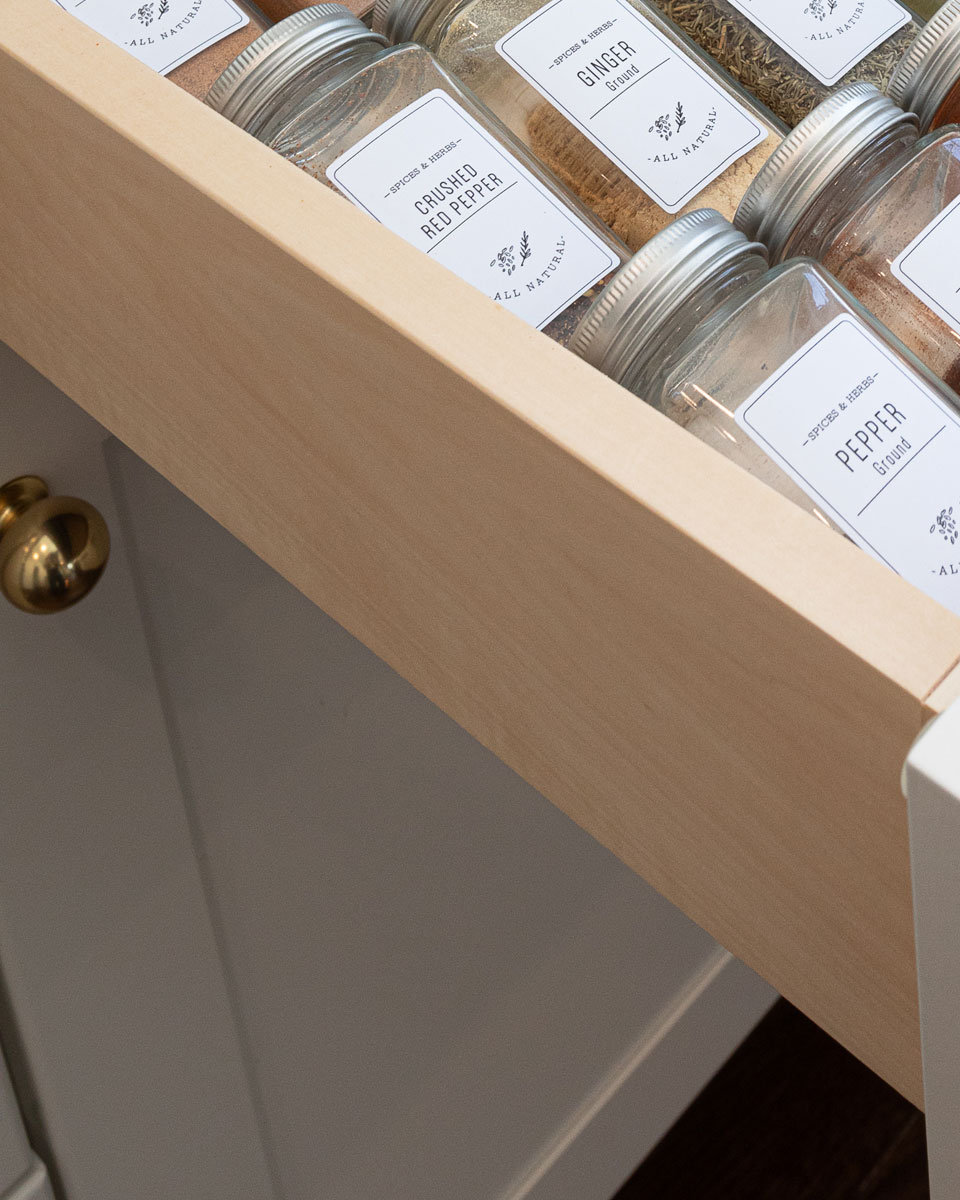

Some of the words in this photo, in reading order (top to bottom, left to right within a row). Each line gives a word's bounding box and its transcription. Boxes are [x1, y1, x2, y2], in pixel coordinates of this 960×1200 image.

[577, 41, 636, 87] GINGER
[605, 63, 640, 92] Ground
[420, 162, 430, 170] &
[414, 164, 477, 215] CRUSHED
[420, 211, 452, 239] RED
[449, 173, 503, 216] PEPPER
[838, 402, 848, 411] &
[835, 403, 906, 473] PEPPER
[872, 436, 912, 476] Ground
